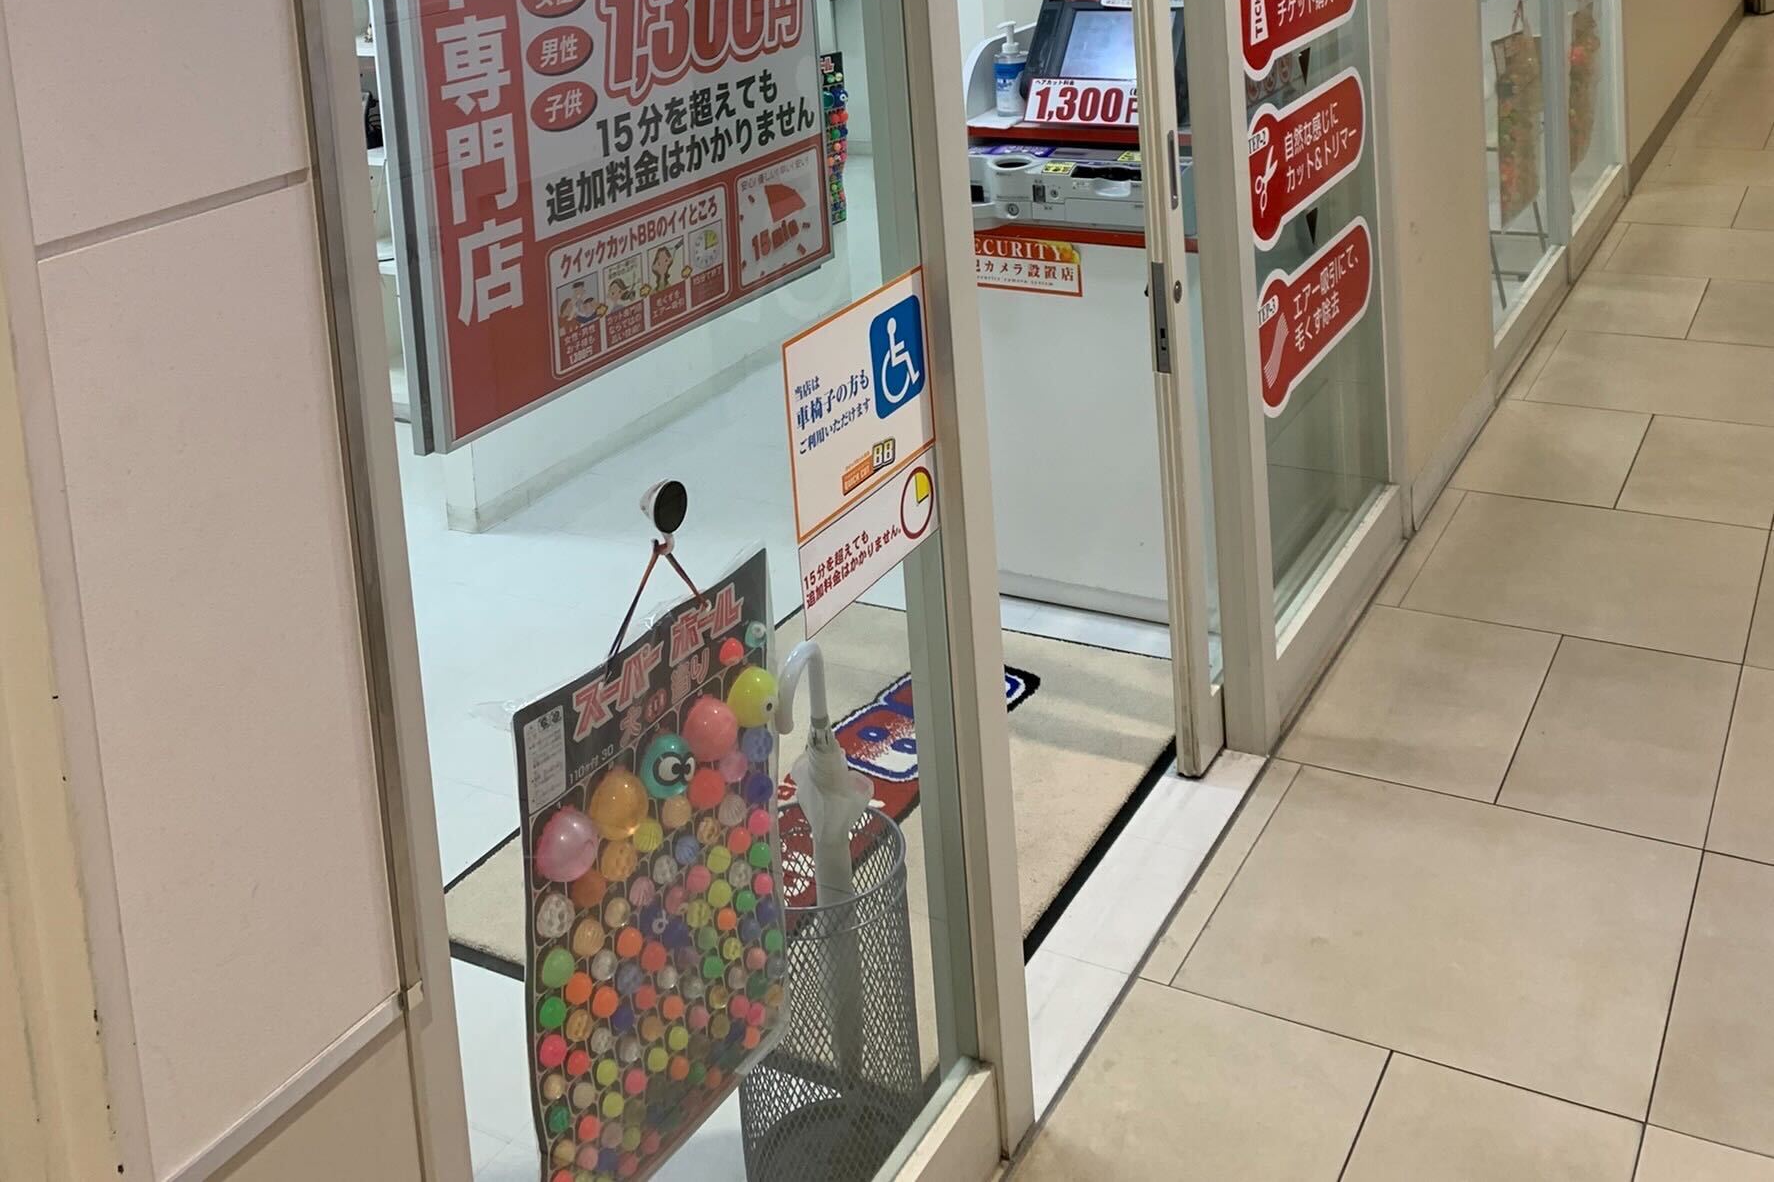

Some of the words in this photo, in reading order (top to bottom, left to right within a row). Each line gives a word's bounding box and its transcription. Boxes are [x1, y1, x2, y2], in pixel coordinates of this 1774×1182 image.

[540, 33, 579, 68] 男性
[544, 89, 584, 124] 子供
[596, 69, 778, 157] 15分を超えても
[1284, 102, 1338, 162] 自然な感じに
[545, 96, 815, 226] 追加料金はかかりません
[1286, 128, 1357, 193] カット&トリマー
[560, 195, 718, 279] クイックカットBBのイイところ
[1293, 244, 1359, 320] エアー吸引にて、
[794, 375, 821, 401] 当店は
[797, 369, 870, 430] 車椅子の方も
[799, 397, 871, 455] ご利用いただけます
[803, 530, 869, 590] 15分を超えても
[806, 525, 901, 609] 追加料金はかかりません。
